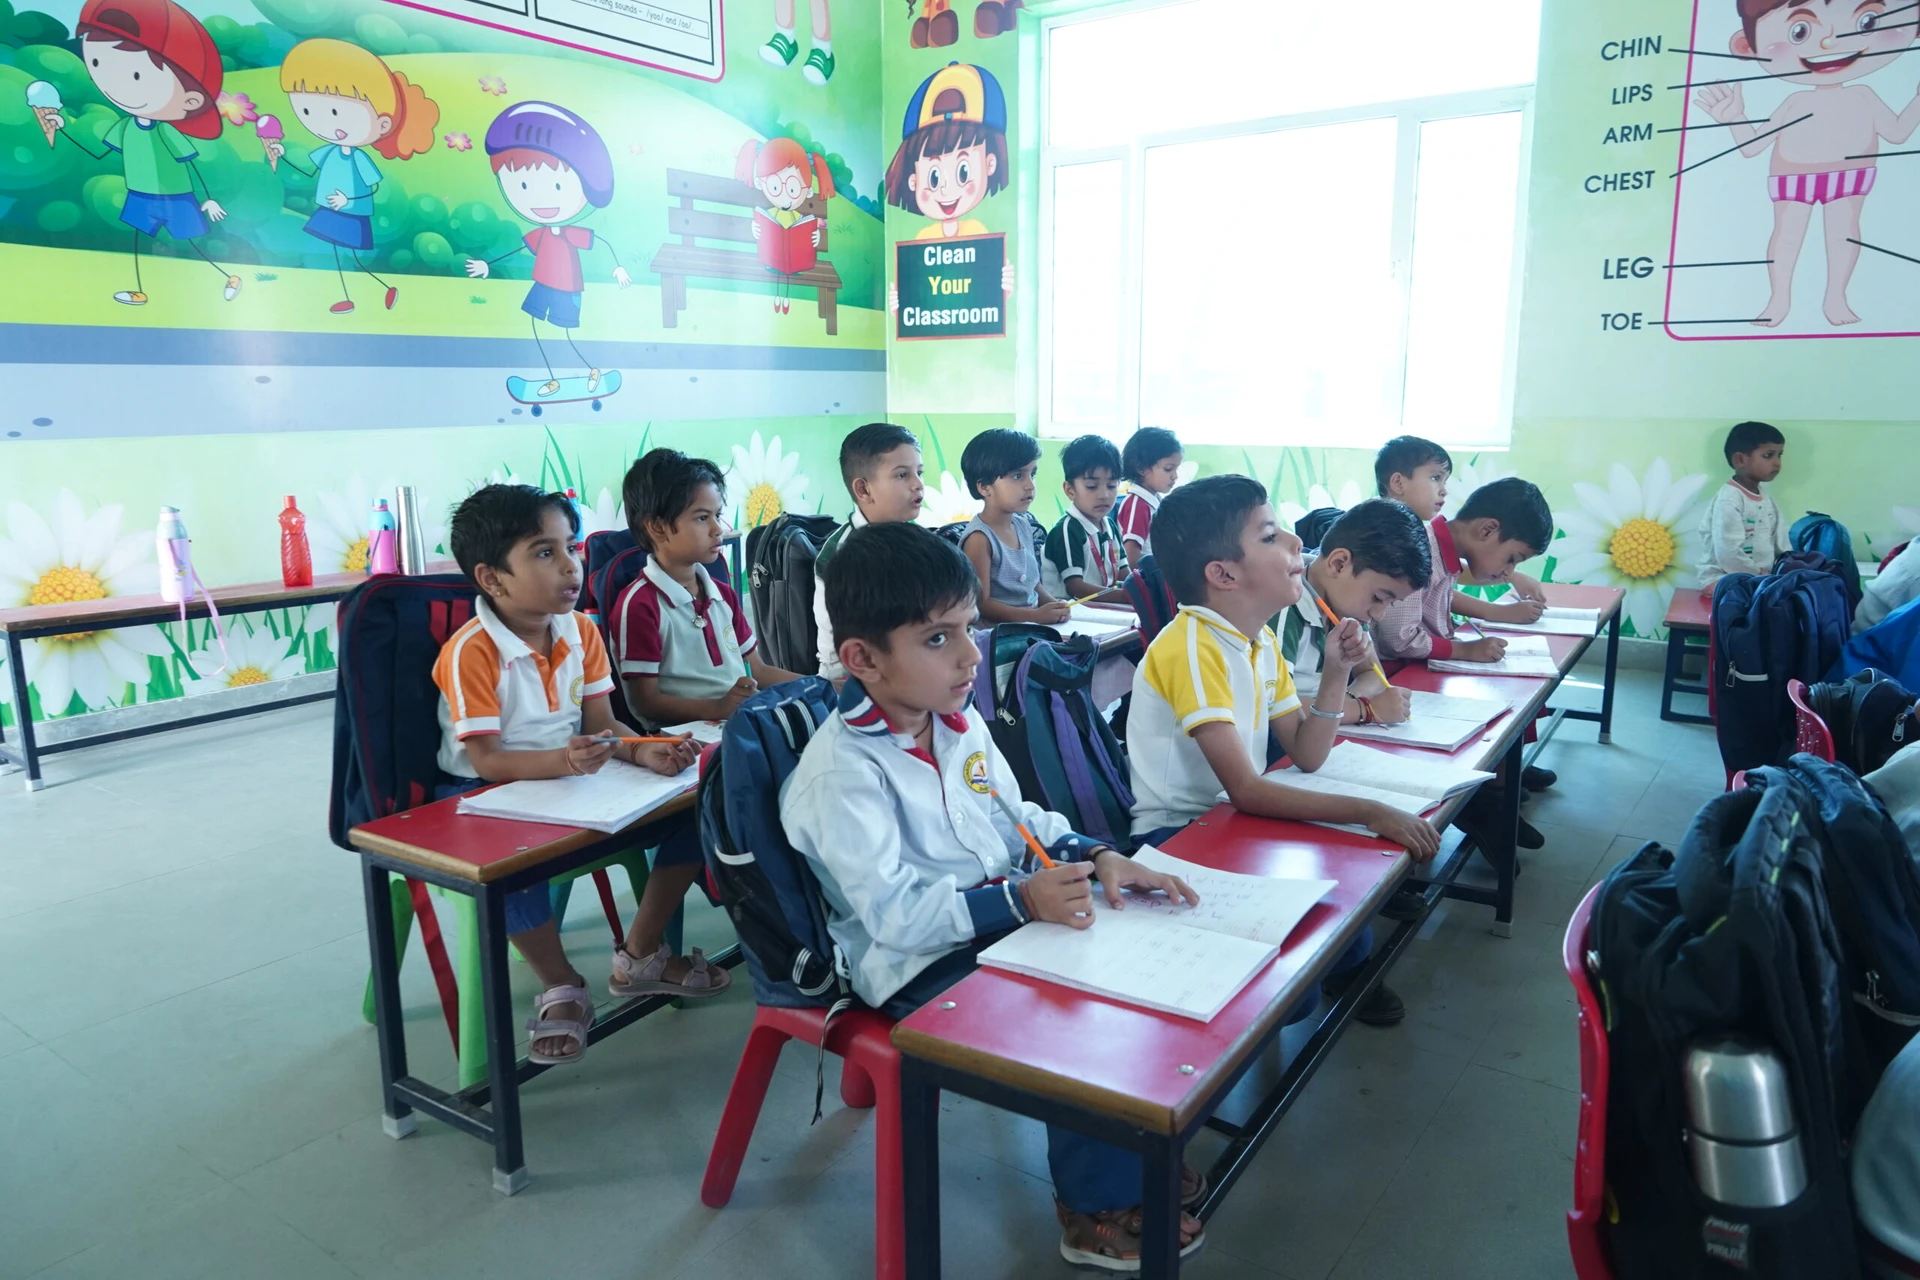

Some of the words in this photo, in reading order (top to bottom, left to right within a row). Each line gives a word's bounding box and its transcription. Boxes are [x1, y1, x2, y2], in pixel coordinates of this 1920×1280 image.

[615, 2, 637, 14] sounds
[665, 16, 677, 26] and
[1601, 35, 1662, 61] CHIN
[1612, 84, 1653, 105] LIPS
[1602, 123, 1653, 145] ARM
[1584, 170, 1656, 194] CHEST
[924, 245, 976, 266] Clean
[1602, 256, 1655, 280] LEG
[928, 275, 972, 295] Your
[903, 306, 999, 327] Classroom
[1601, 312, 1643, 331] TOE
